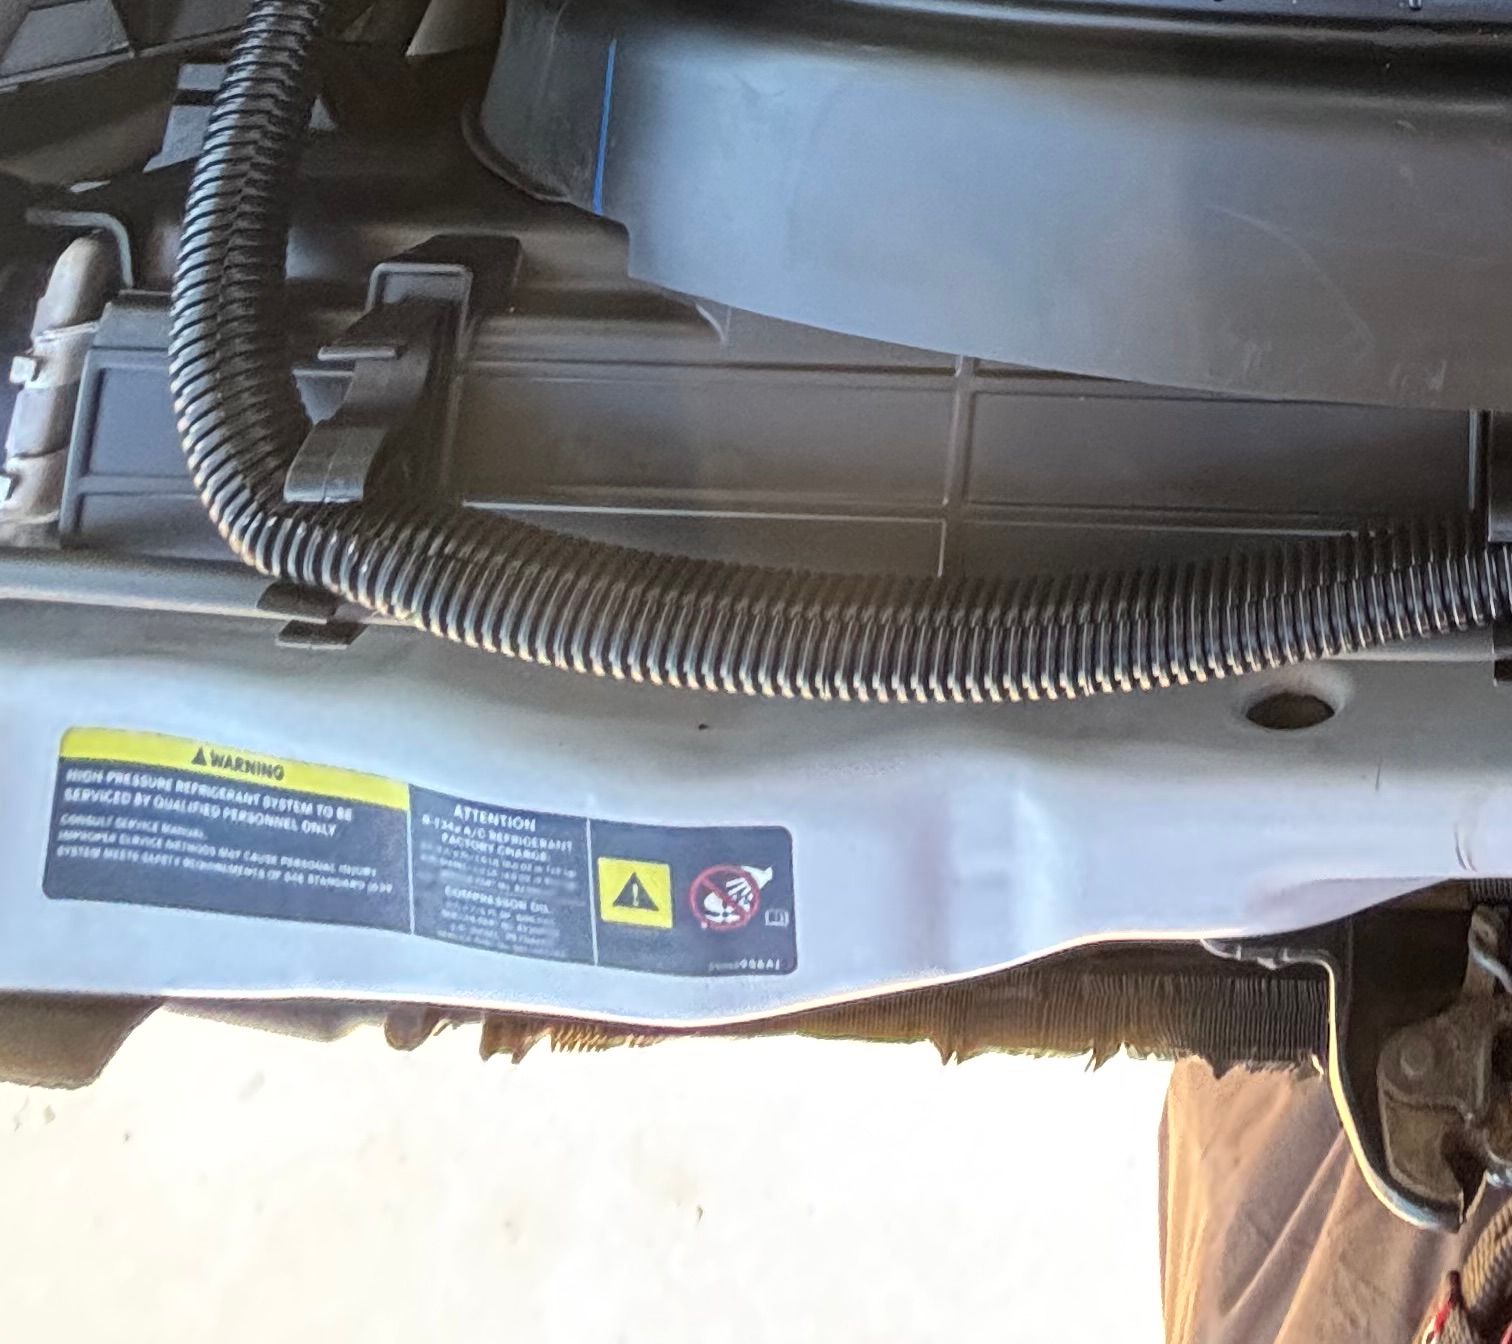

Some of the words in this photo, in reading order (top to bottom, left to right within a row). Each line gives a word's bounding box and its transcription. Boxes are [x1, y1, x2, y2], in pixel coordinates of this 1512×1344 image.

[211, 752, 285, 780] WARNING
[64, 787, 132, 806] SERVICED
[133, 792, 151, 807] BY
[153, 793, 221, 819] QUALIFIED
[222, 806, 298, 832] PERSONNEL
[301, 819, 337, 837] ONLY
[66, 768, 104, 784] HIGH
[106, 770, 174, 792] PRESSURE
[175, 779, 261, 806] REFRIGERANT
[262, 795, 313, 815] SYSTEM
[317, 804, 334, 819] TO
[336, 806, 352, 822] BE
[454, 804, 536, 832] ATTENTION
